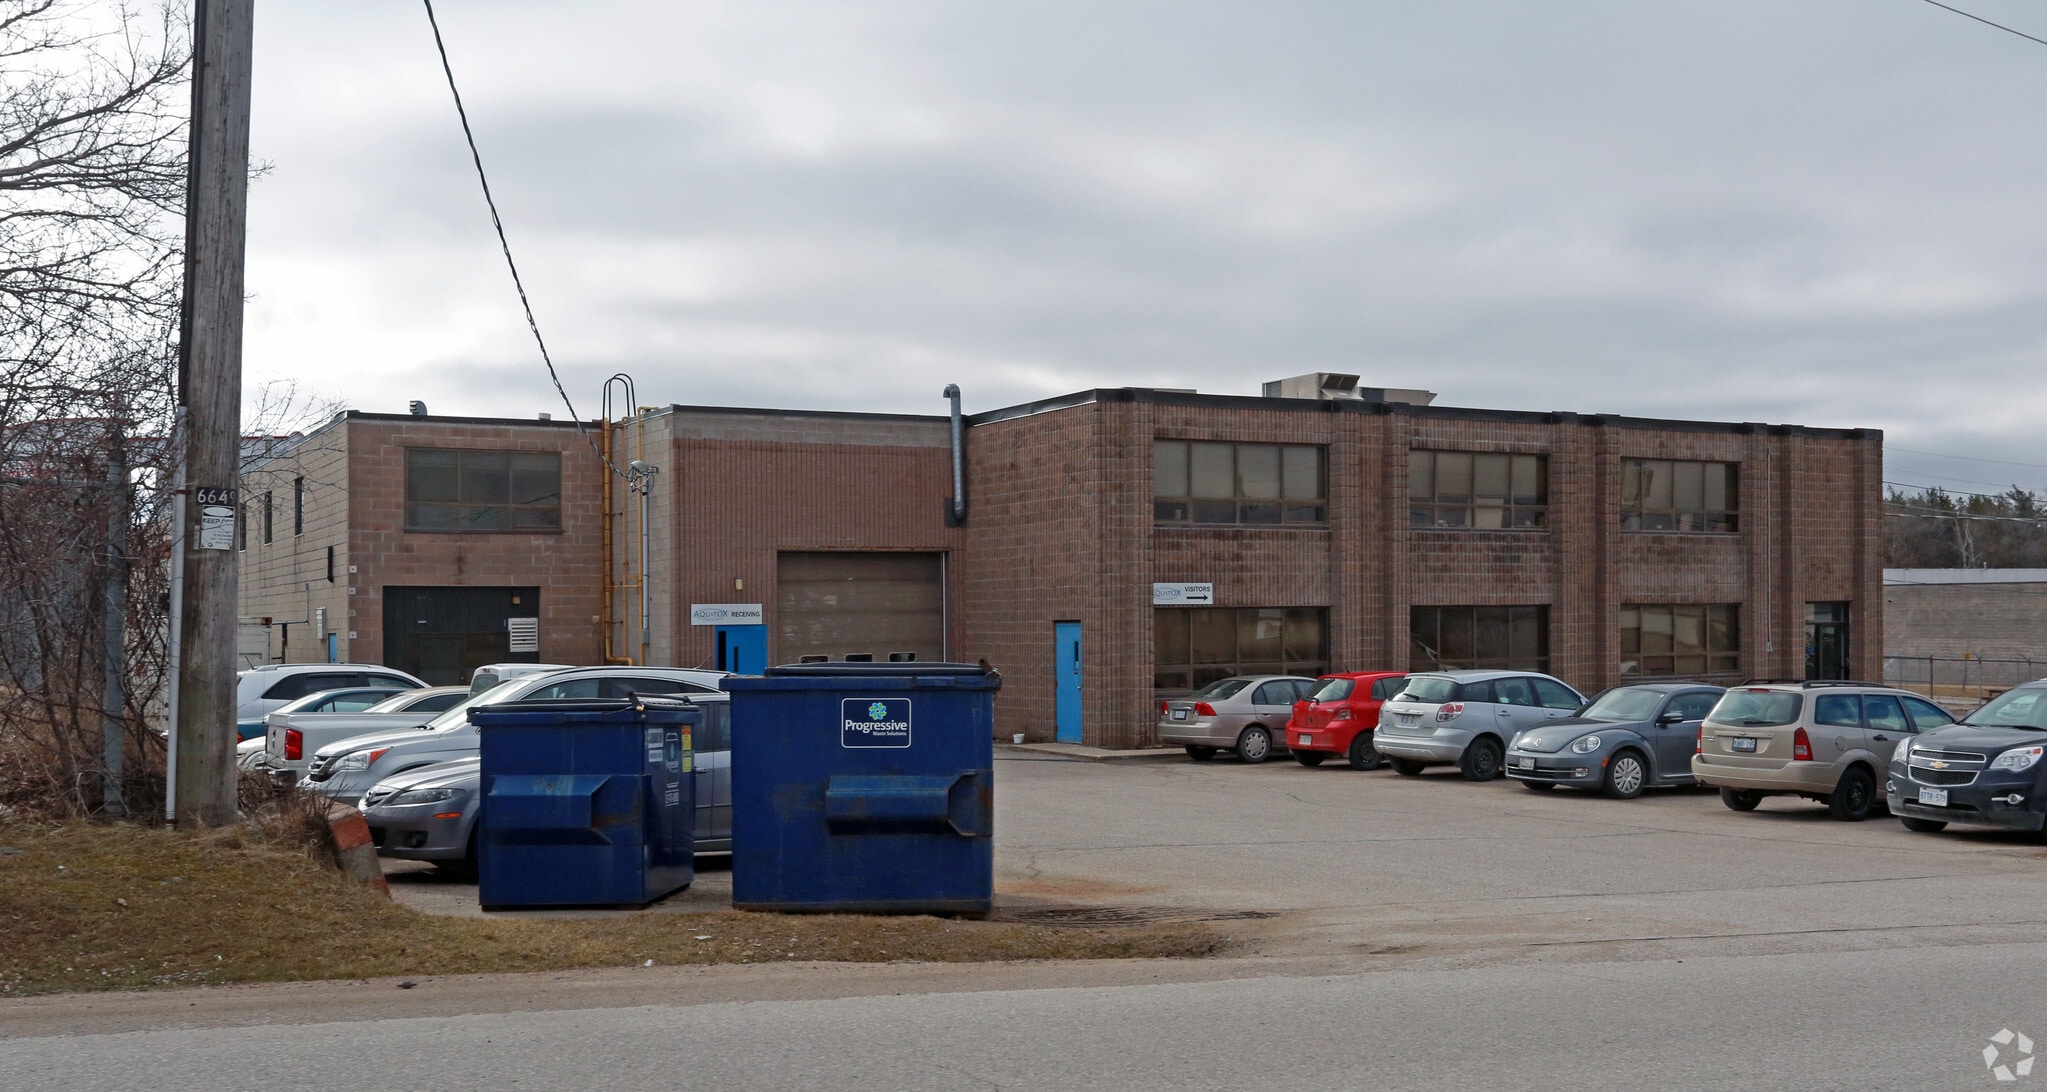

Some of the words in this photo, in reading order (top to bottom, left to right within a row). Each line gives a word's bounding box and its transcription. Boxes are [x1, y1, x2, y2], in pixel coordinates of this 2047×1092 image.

[1154, 589, 1181, 597] QUATOX
[693, 610, 728, 618] AQUATOX
[845, 720, 908, 734] Progressive
